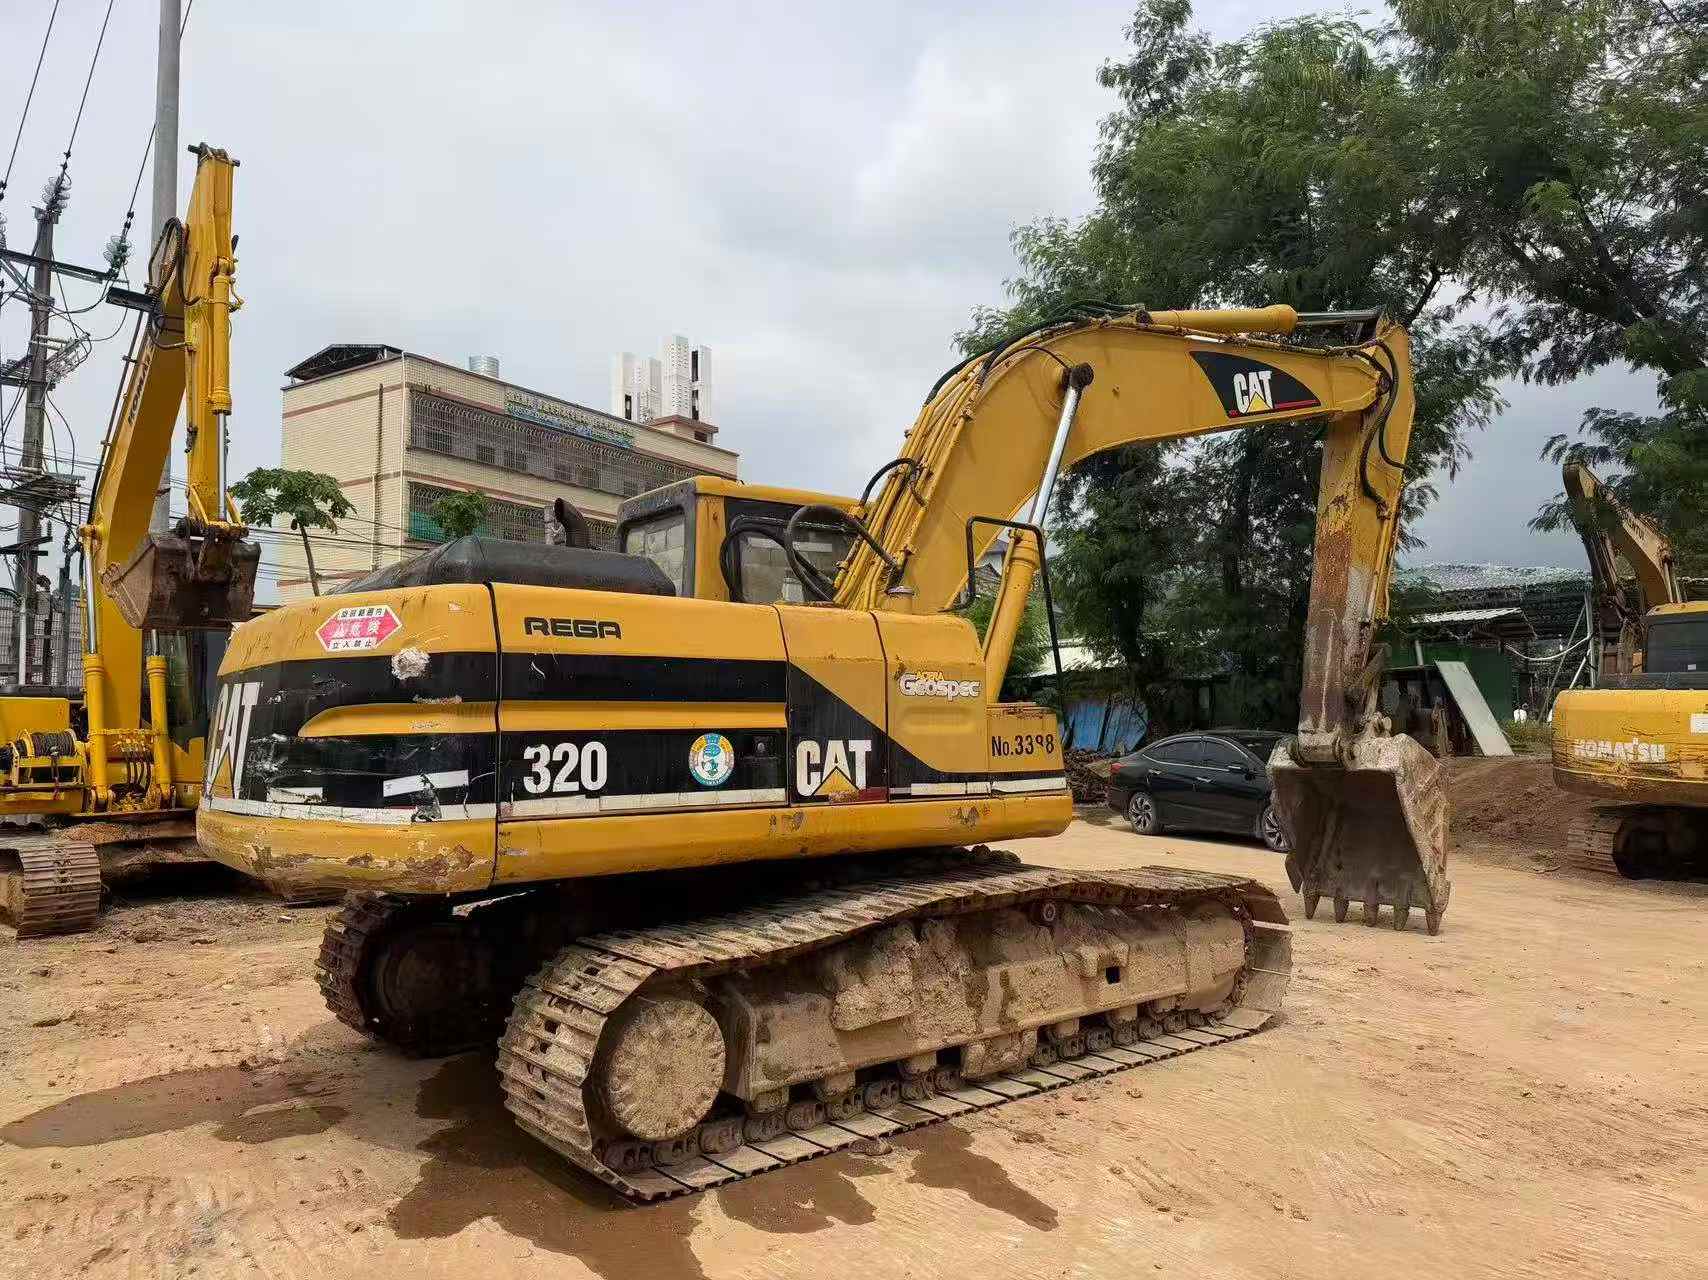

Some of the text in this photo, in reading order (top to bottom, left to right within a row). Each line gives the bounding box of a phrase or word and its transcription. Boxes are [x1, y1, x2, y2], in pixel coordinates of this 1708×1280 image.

[1233, 370, 1273, 413] CAT
[524, 617, 622, 640] REGA
[899, 672, 981, 702] Geospec
[205, 681, 263, 800] CAT
[523, 741, 608, 794] 320
[796, 739, 872, 797] CAT
